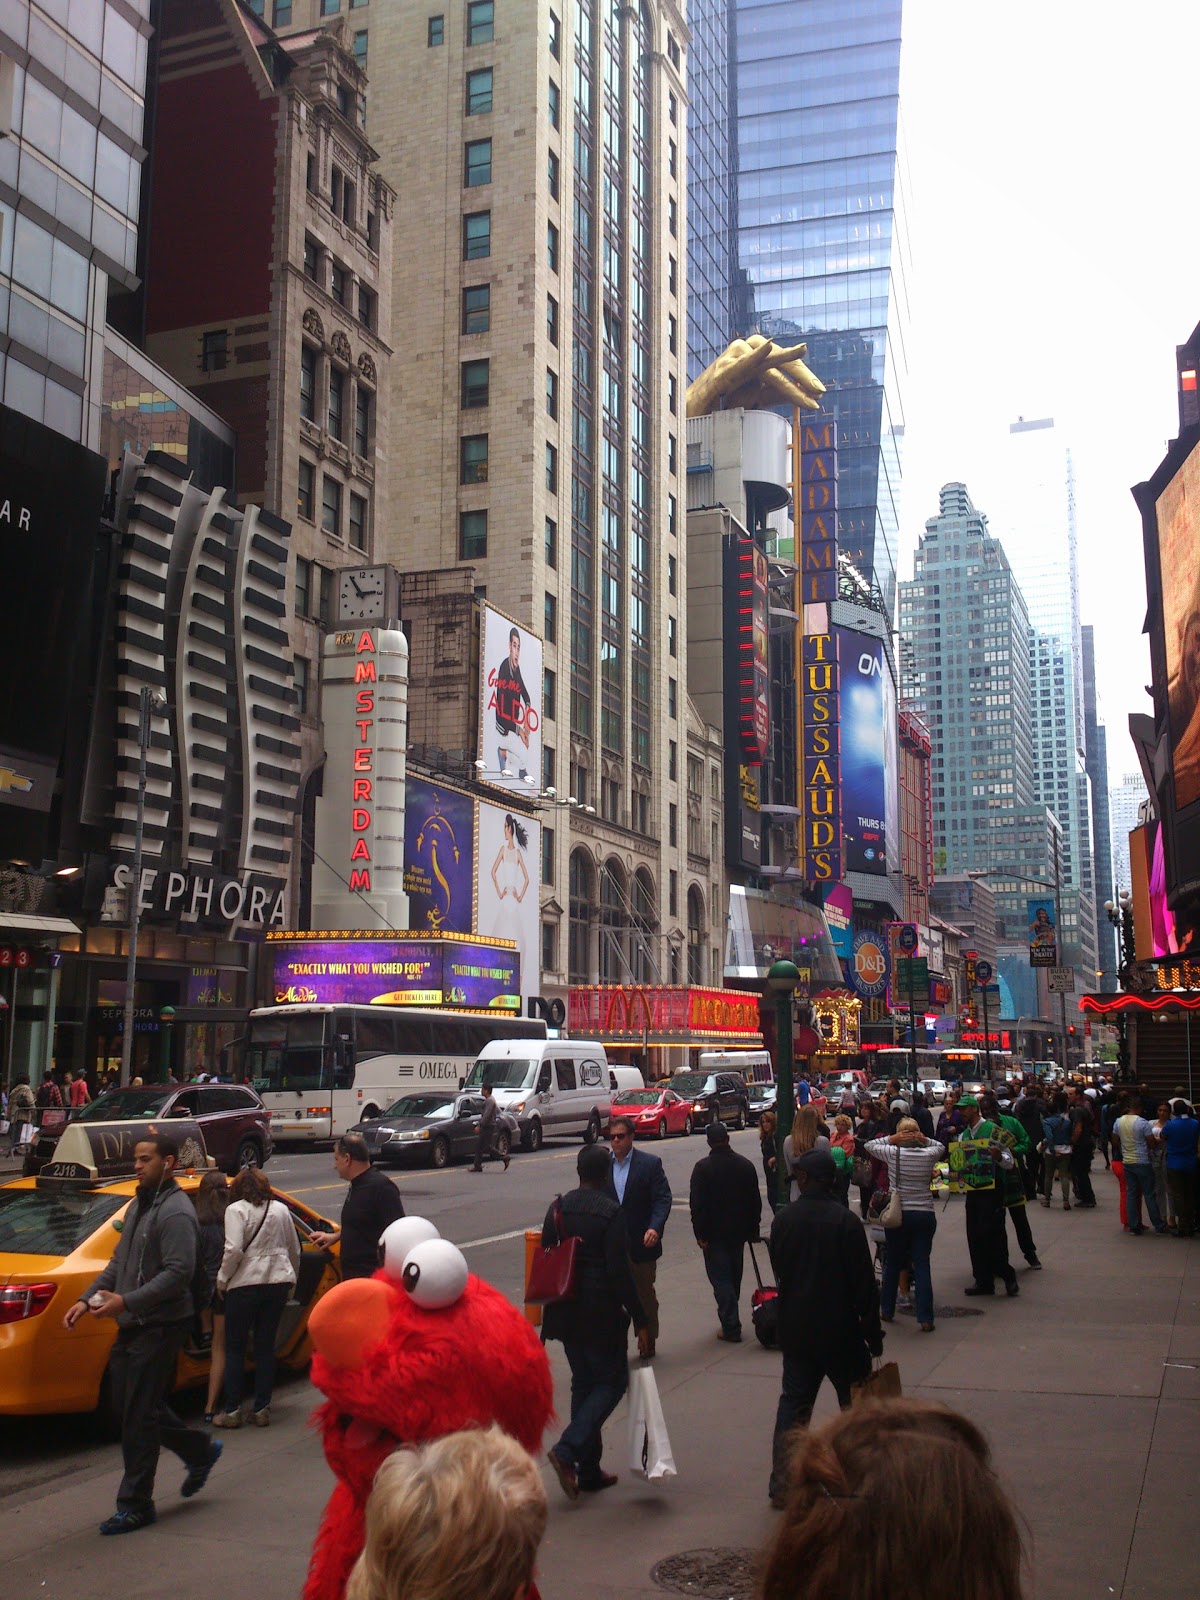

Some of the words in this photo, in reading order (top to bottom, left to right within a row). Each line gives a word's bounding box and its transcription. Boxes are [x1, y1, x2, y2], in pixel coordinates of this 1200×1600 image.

[804, 424, 832, 600] MADAME
[359, 571, 366, 579] 12
[487, 690, 539, 732] ALDO
[350, 631, 377, 892] AMSTERDAM
[857, 816, 880, 829] THURS
[113, 864, 286, 926] SEPHORA
[853, 934, 873, 952] DAVE
[870, 936, 885, 952] AND
[2, 950, 10, 963] 2
[19, 951, 27, 965] 3
[53, 954, 61, 966] 7
[854, 953, 887, 974] D&B
[287, 962, 327, 975] “EXACTLY
[328, 962, 351, 975] WHAT
[352, 962, 371, 975] YOU
[371, 962, 403, 975] WISHED
[404, 961, 430, 974] FOR!”
[275, 985, 318, 1003] Aladdin
[102, 1008, 153, 1019] SEPORA
[420, 1061, 458, 1079] OMEGA
[53, 1164, 76, 1177] 2J18
